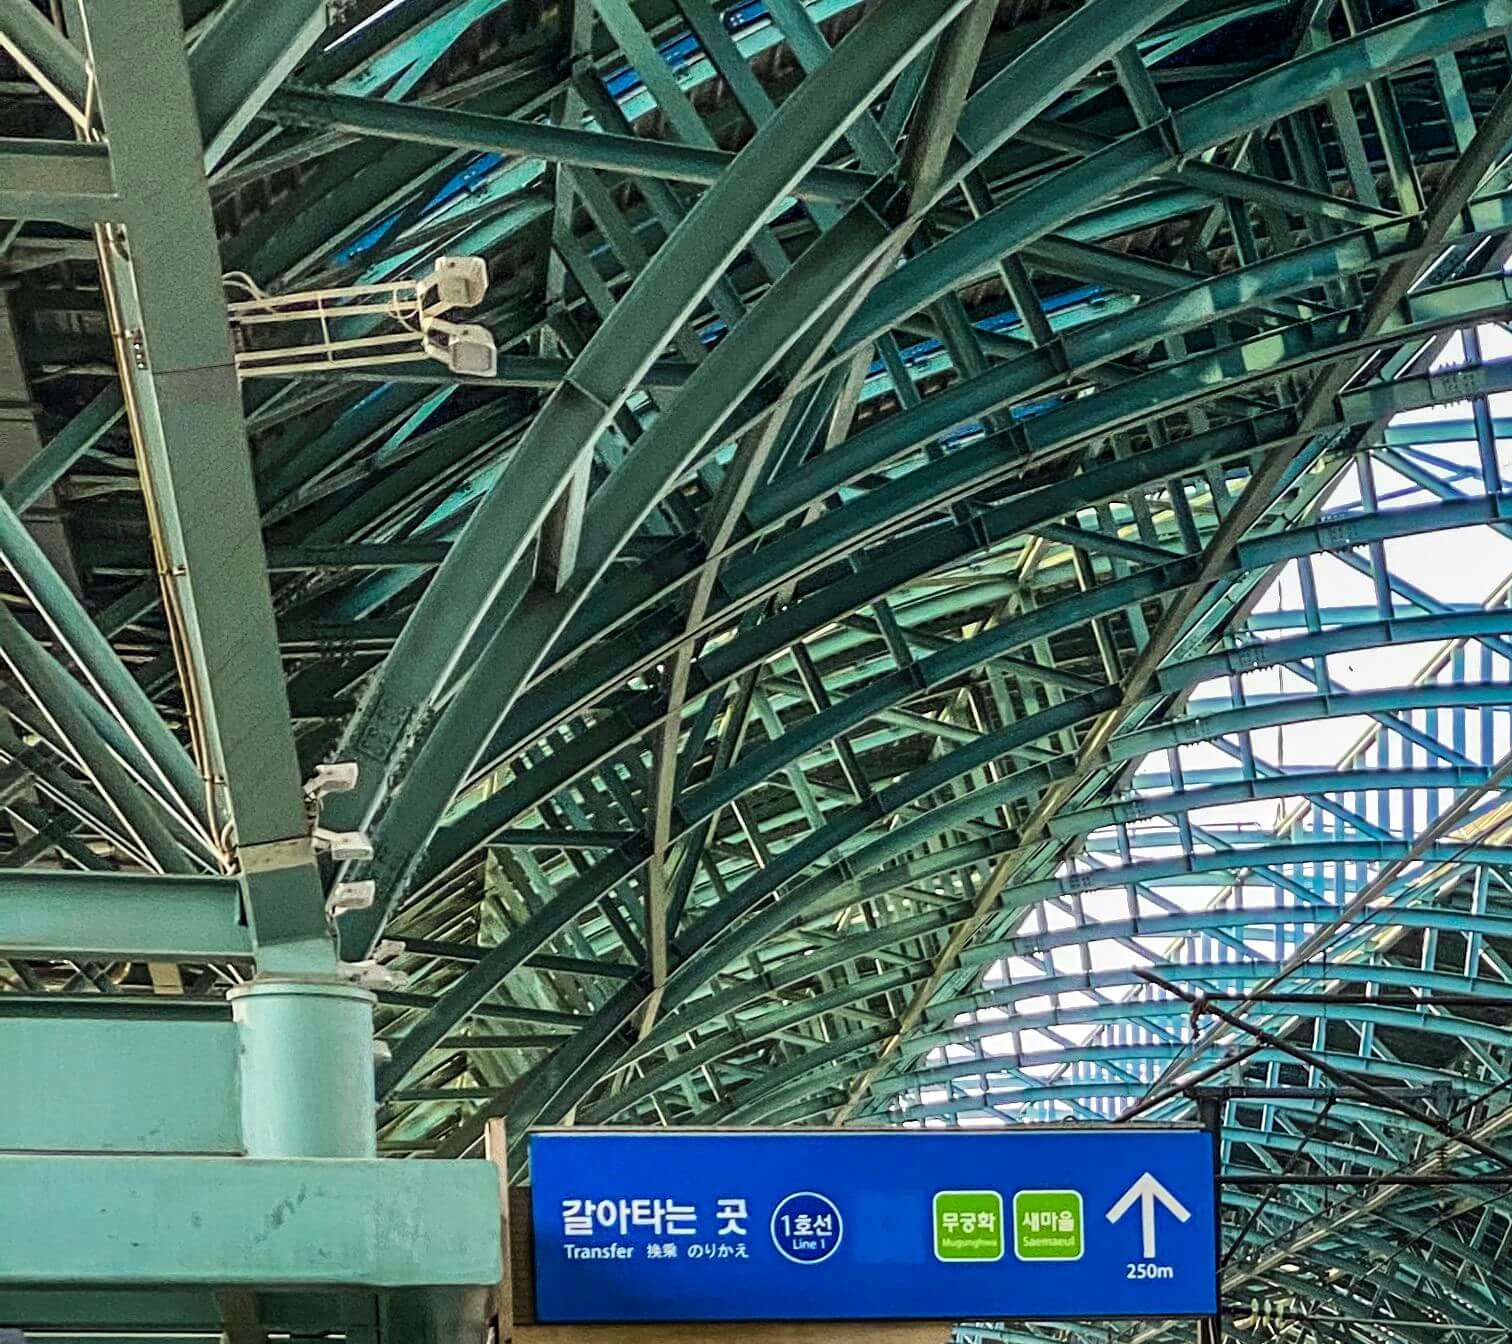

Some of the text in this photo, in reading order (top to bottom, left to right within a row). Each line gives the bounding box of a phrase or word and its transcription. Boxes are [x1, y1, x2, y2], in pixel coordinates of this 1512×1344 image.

[562, 1199, 748, 1236] 갈아타는 곳
[781, 1214, 833, 1236] 1호선
[942, 1211, 996, 1233] 무궁화
[1022, 1210, 1075, 1233] 새마을
[564, 1243, 634, 1260] Transfer
[687, 1243, 749, 1259] のりかえ
[793, 1238, 826, 1250] Line 1
[1126, 1263, 1174, 1279] 250m
